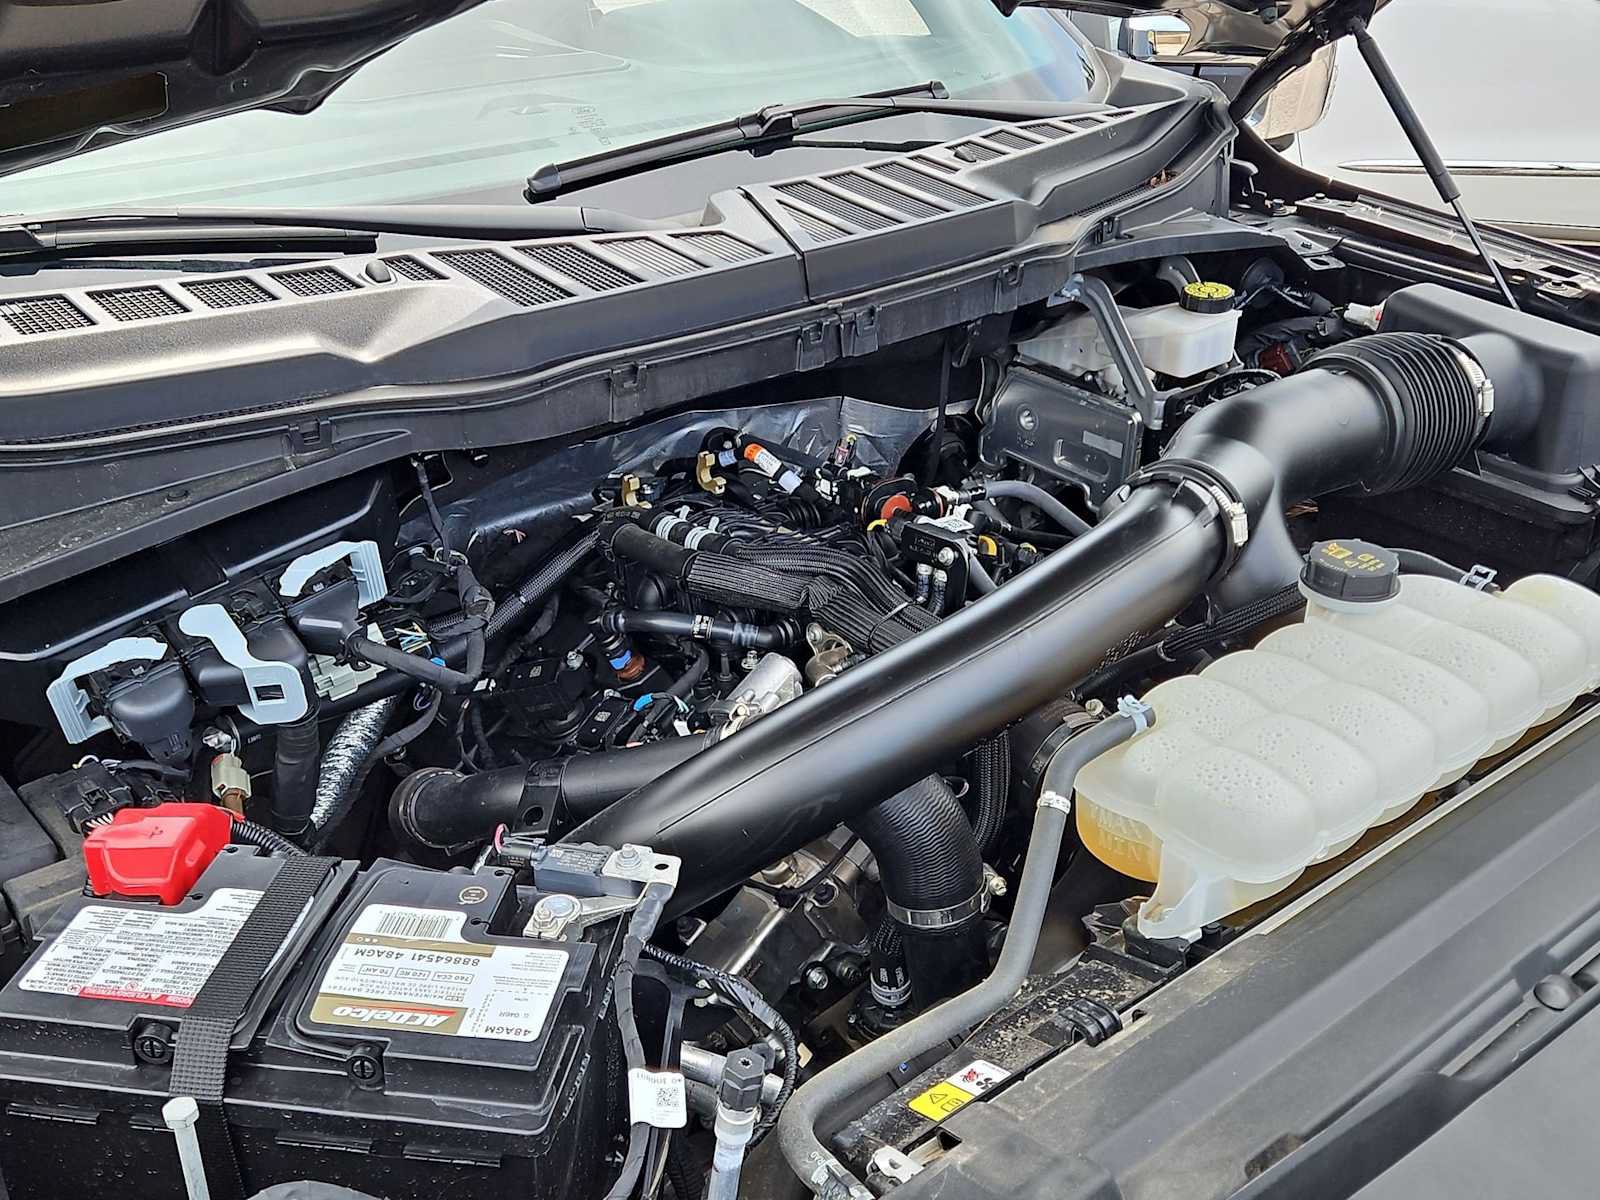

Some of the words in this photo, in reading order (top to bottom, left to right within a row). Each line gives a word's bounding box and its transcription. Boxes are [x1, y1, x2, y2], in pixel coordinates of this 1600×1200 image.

[352, 946, 404, 960] 48AGM
[410, 951, 481, 967] 88864541
[329, 1005, 449, 1028] ACDelco
[482, 1024, 532, 1037] 48AGM
